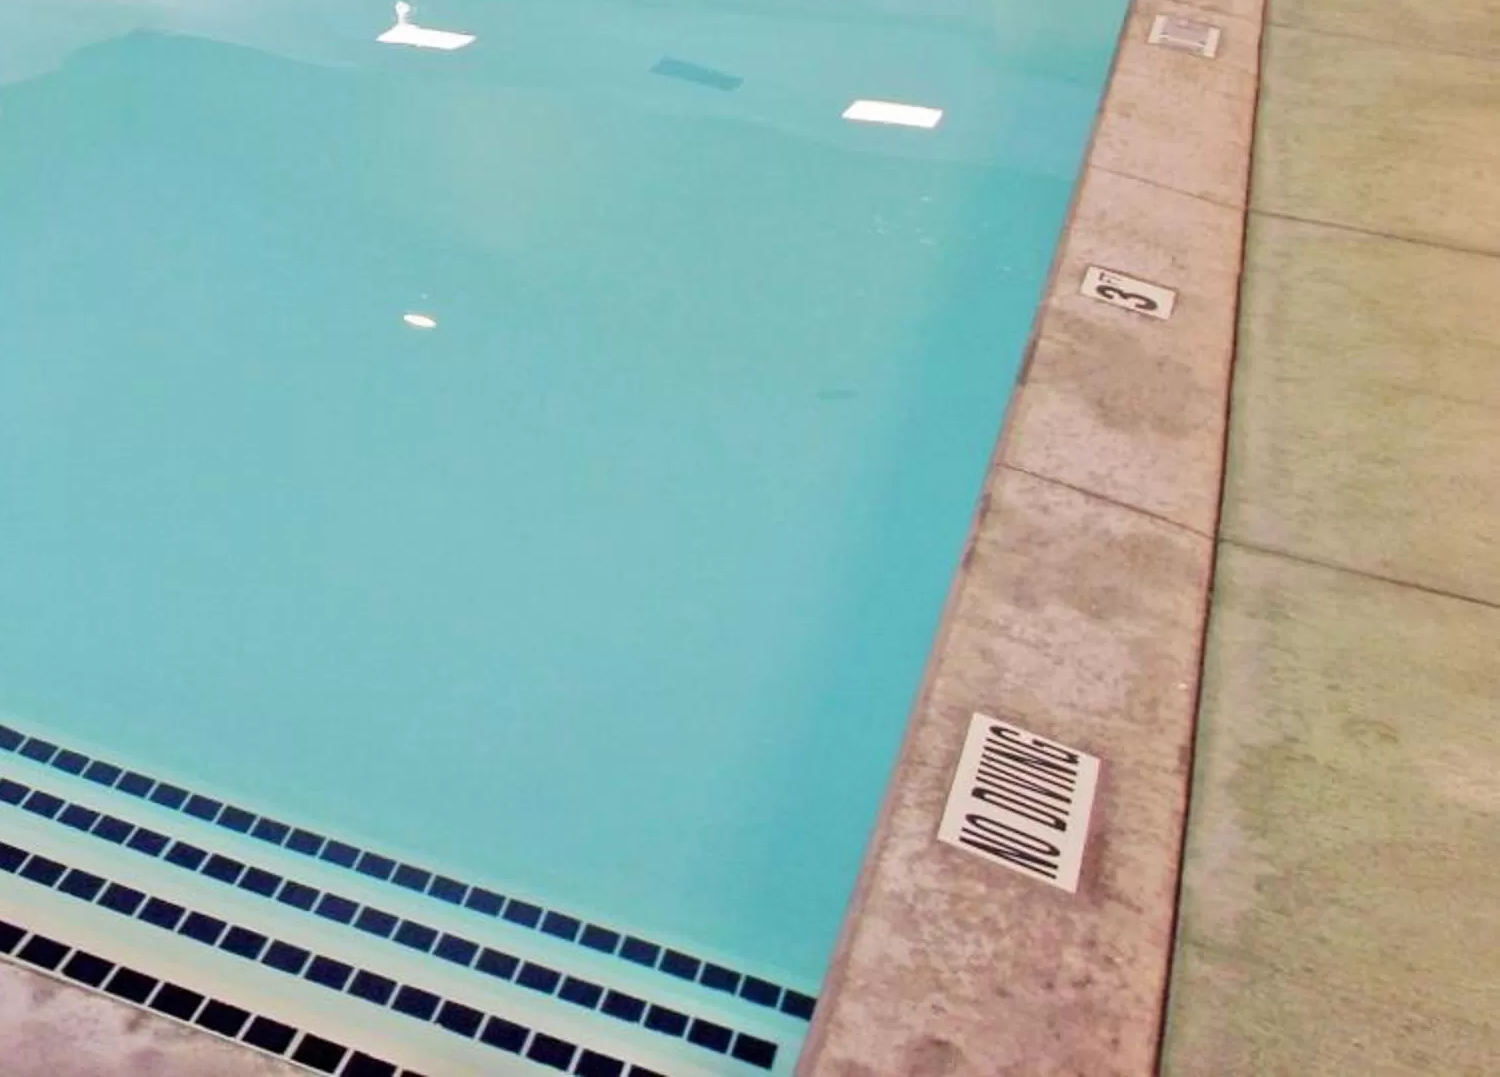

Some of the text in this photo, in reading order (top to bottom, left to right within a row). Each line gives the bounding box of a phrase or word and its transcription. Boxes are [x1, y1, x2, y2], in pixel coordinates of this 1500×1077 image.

[1096, 285, 1158, 311] 3
[959, 725, 1080, 880] NO DIVING
